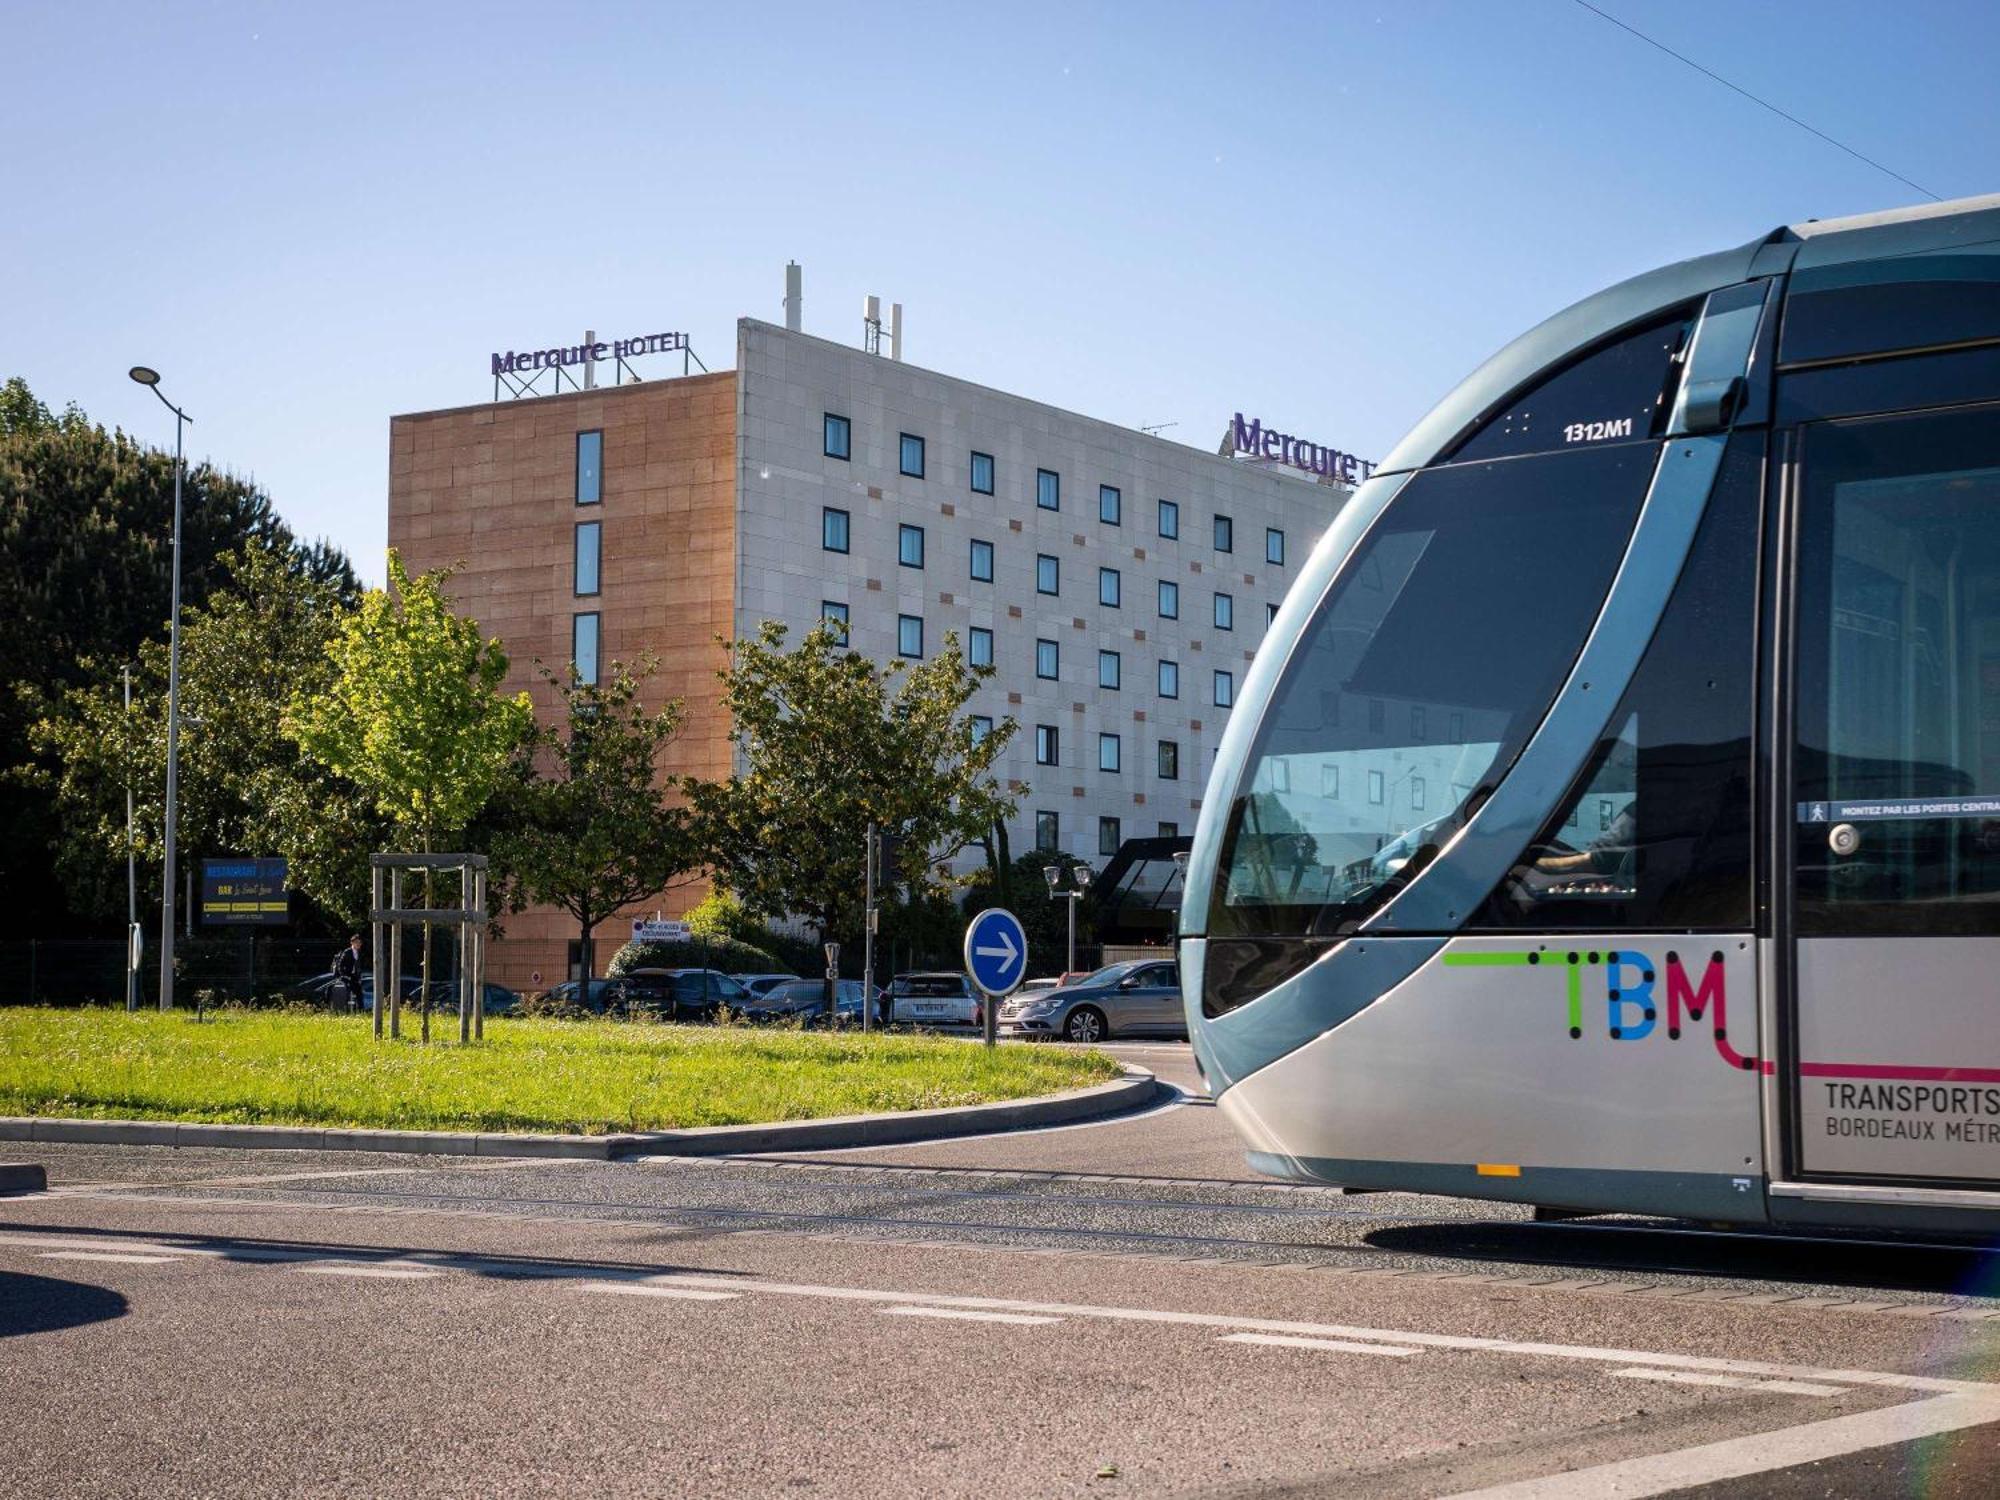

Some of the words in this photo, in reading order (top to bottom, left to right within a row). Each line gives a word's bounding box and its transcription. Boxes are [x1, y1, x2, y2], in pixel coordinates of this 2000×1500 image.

[491, 341, 608, 375] Mercure
[614, 332, 681, 359] HOTEL
[1563, 418, 1632, 442] 1312M1
[1234, 412, 1357, 484] Mercure
[1841, 806, 1881, 817] MONTEZ
[1882, 805, 1902, 815] PAR
[1903, 804, 1921, 814] LES
[1923, 803, 1960, 813] PORTES
[1443, 950, 1740, 1060] TBM
[1825, 1083, 2000, 1115] TRANSPORTS
[1826, 1116, 1935, 1140] BORDEAUX
[1946, 1118, 2000, 1143] MÉTR
